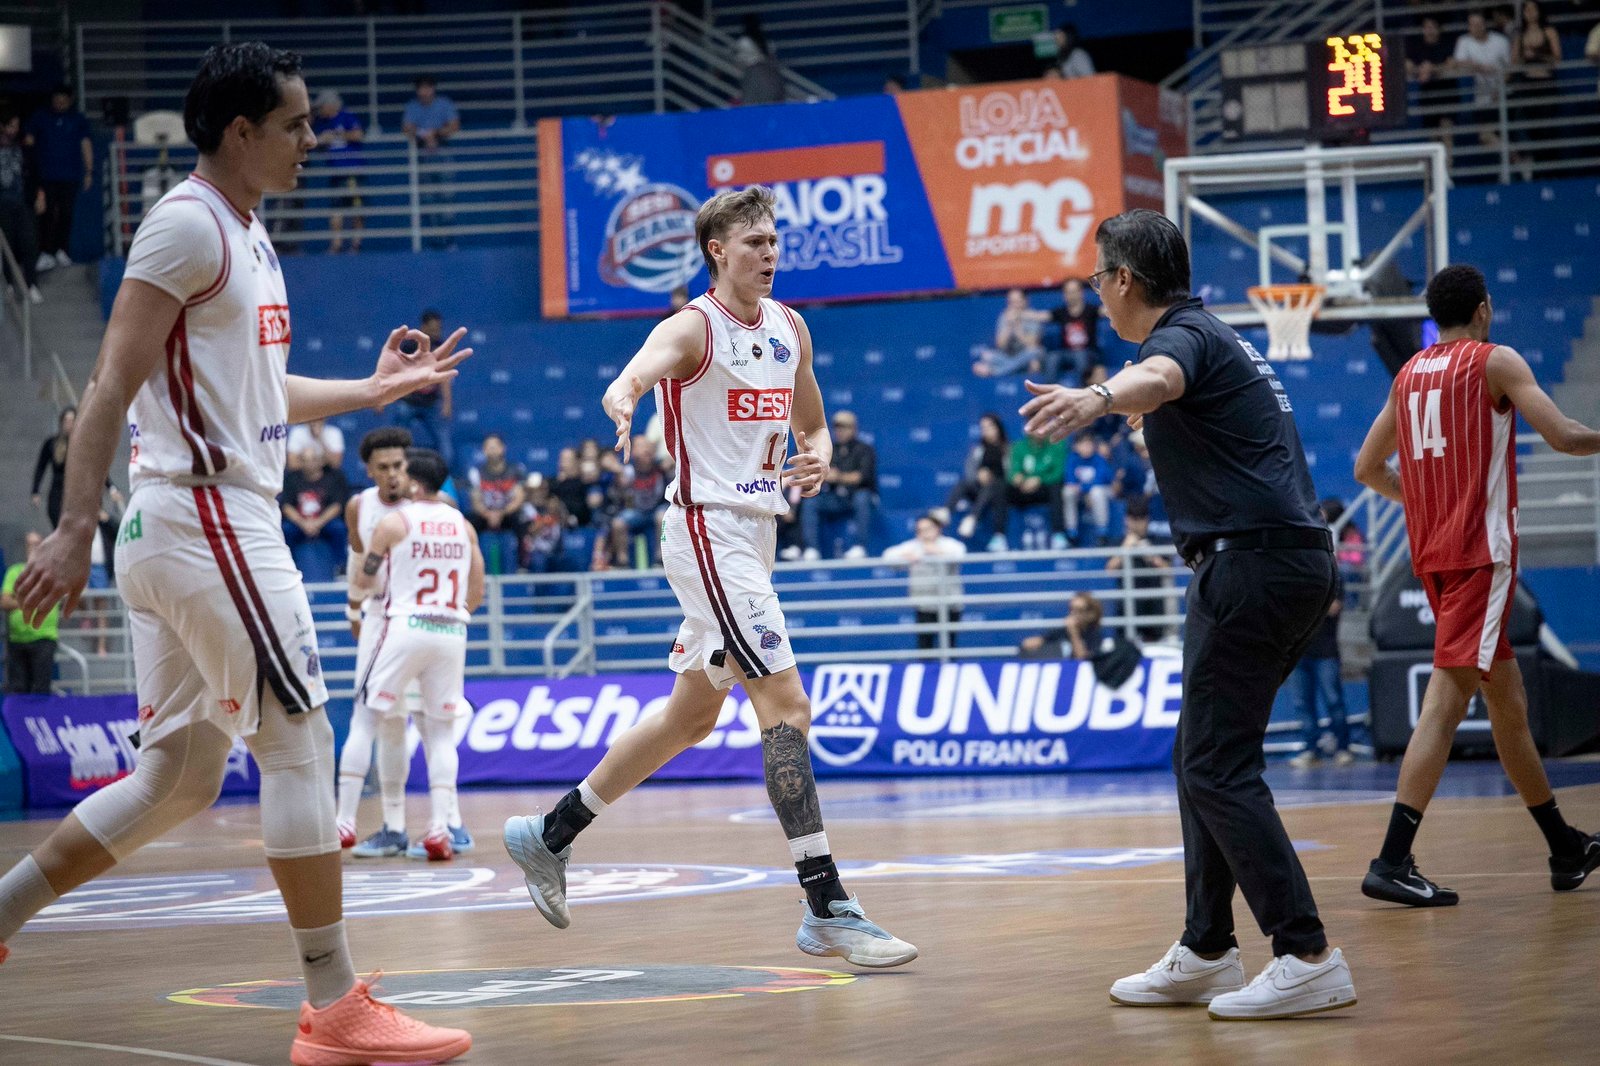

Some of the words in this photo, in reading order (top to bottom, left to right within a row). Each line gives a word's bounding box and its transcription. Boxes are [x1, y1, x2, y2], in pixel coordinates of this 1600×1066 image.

[959, 87, 1069, 136] LOJA
[955, 127, 1090, 170] OFICIAL
[772, 174, 888, 228] AIOR
[776, 220, 904, 272] RASIL
[965, 233, 1041, 259] SPORTS
[736, 393, 793, 419] SESI
[1409, 388, 1447, 460] 14
[762, 432, 788, 471] 1
[411, 541, 464, 560] PAROD
[416, 568, 459, 610] 21
[892, 740, 961, 766] POLO
[963, 738, 1068, 765] FRANCA
